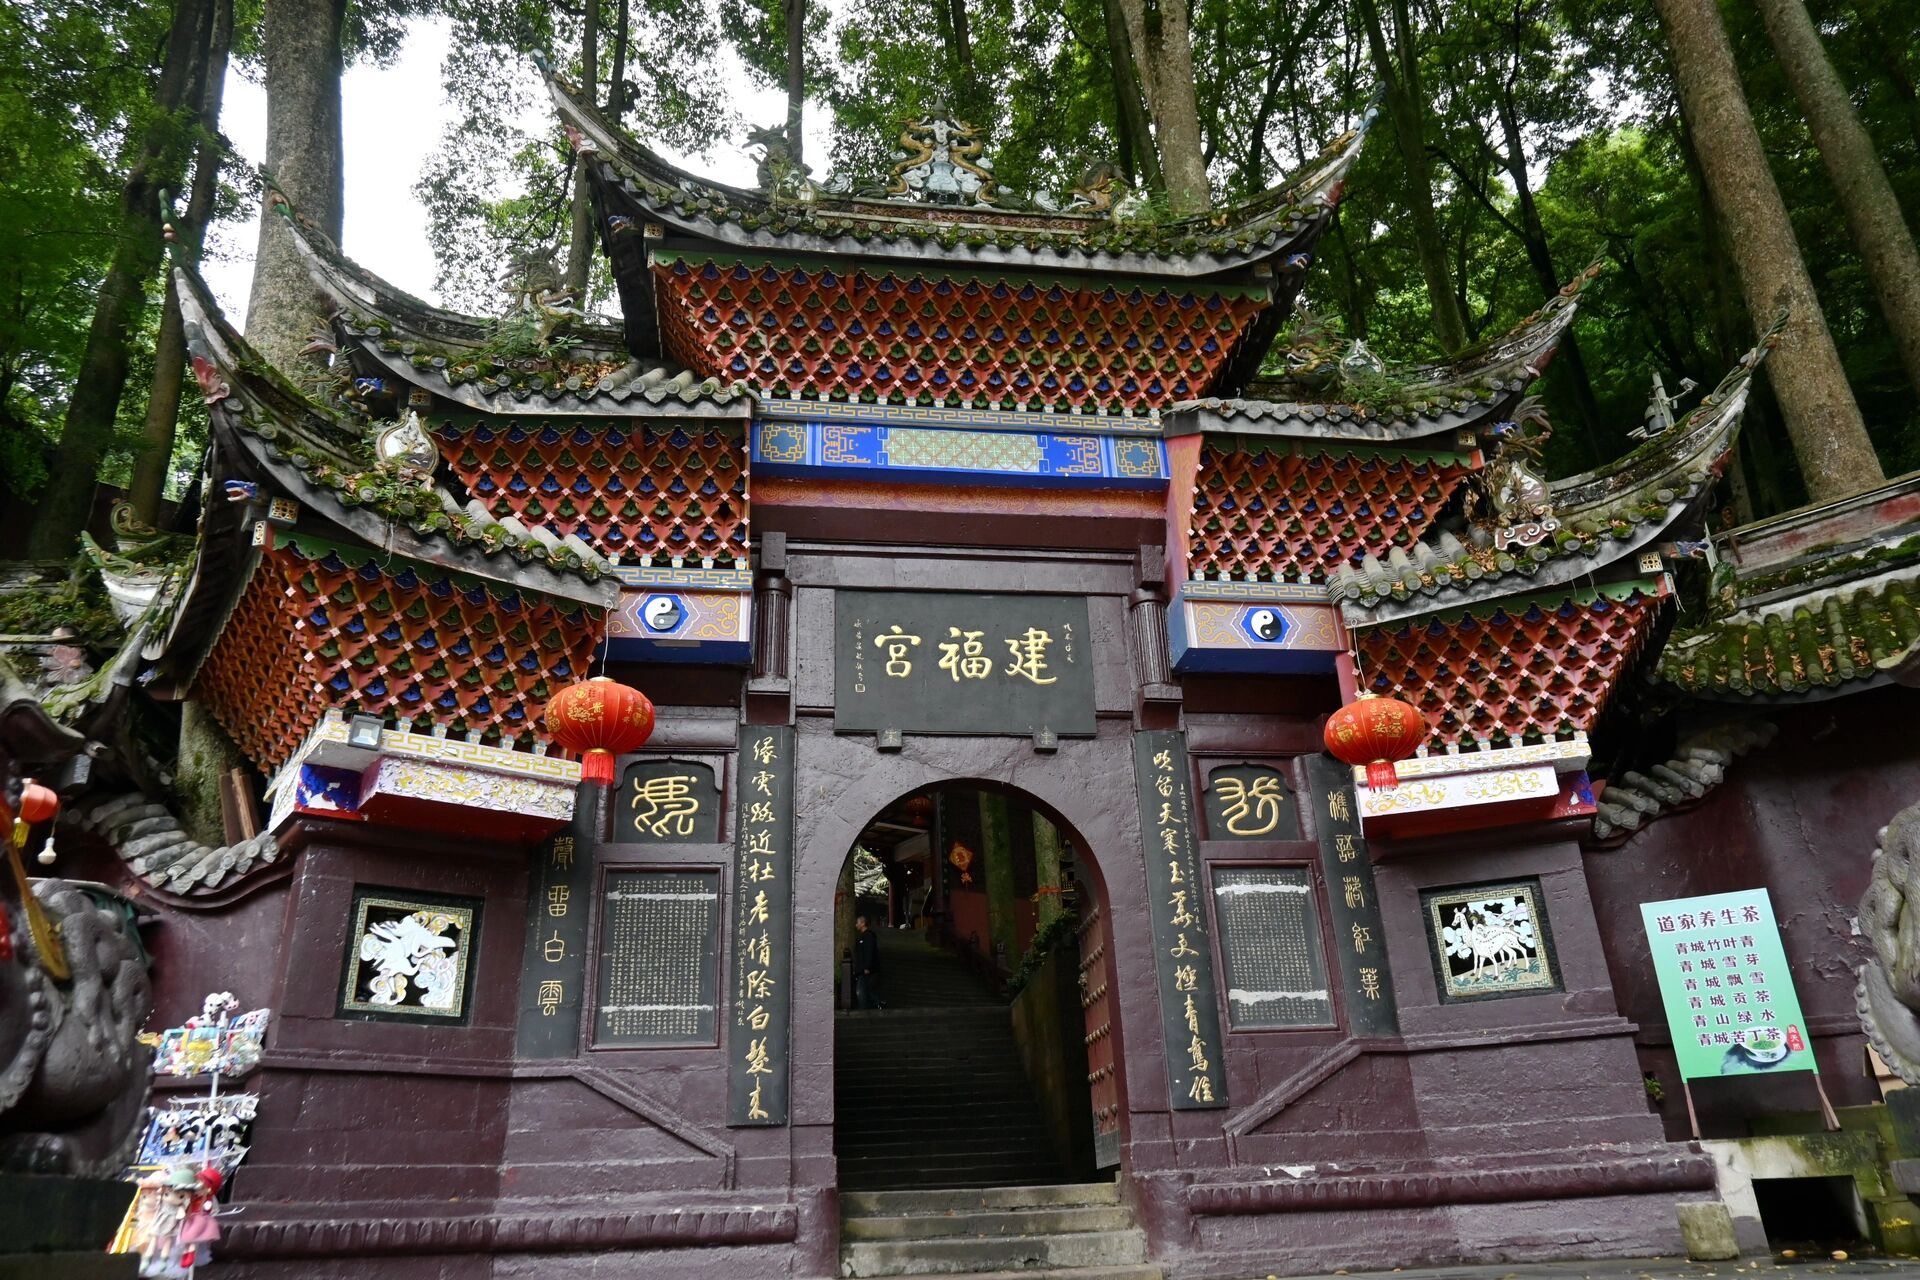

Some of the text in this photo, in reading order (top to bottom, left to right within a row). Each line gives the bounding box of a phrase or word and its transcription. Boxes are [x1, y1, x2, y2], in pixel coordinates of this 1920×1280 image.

[1656, 905, 1761, 933] 道家养生茶
[1675, 935, 1754, 955] 青城竹叶青
[1679, 953, 1760, 973] 青城雪芽
[1684, 971, 1765, 991] 青城飘雪
[1688, 990, 1771, 1009] 青城贡茶
[1693, 1009, 1776, 1028] 青山绿水
[1698, 1028, 1781, 1046] 青城苦丁茶
